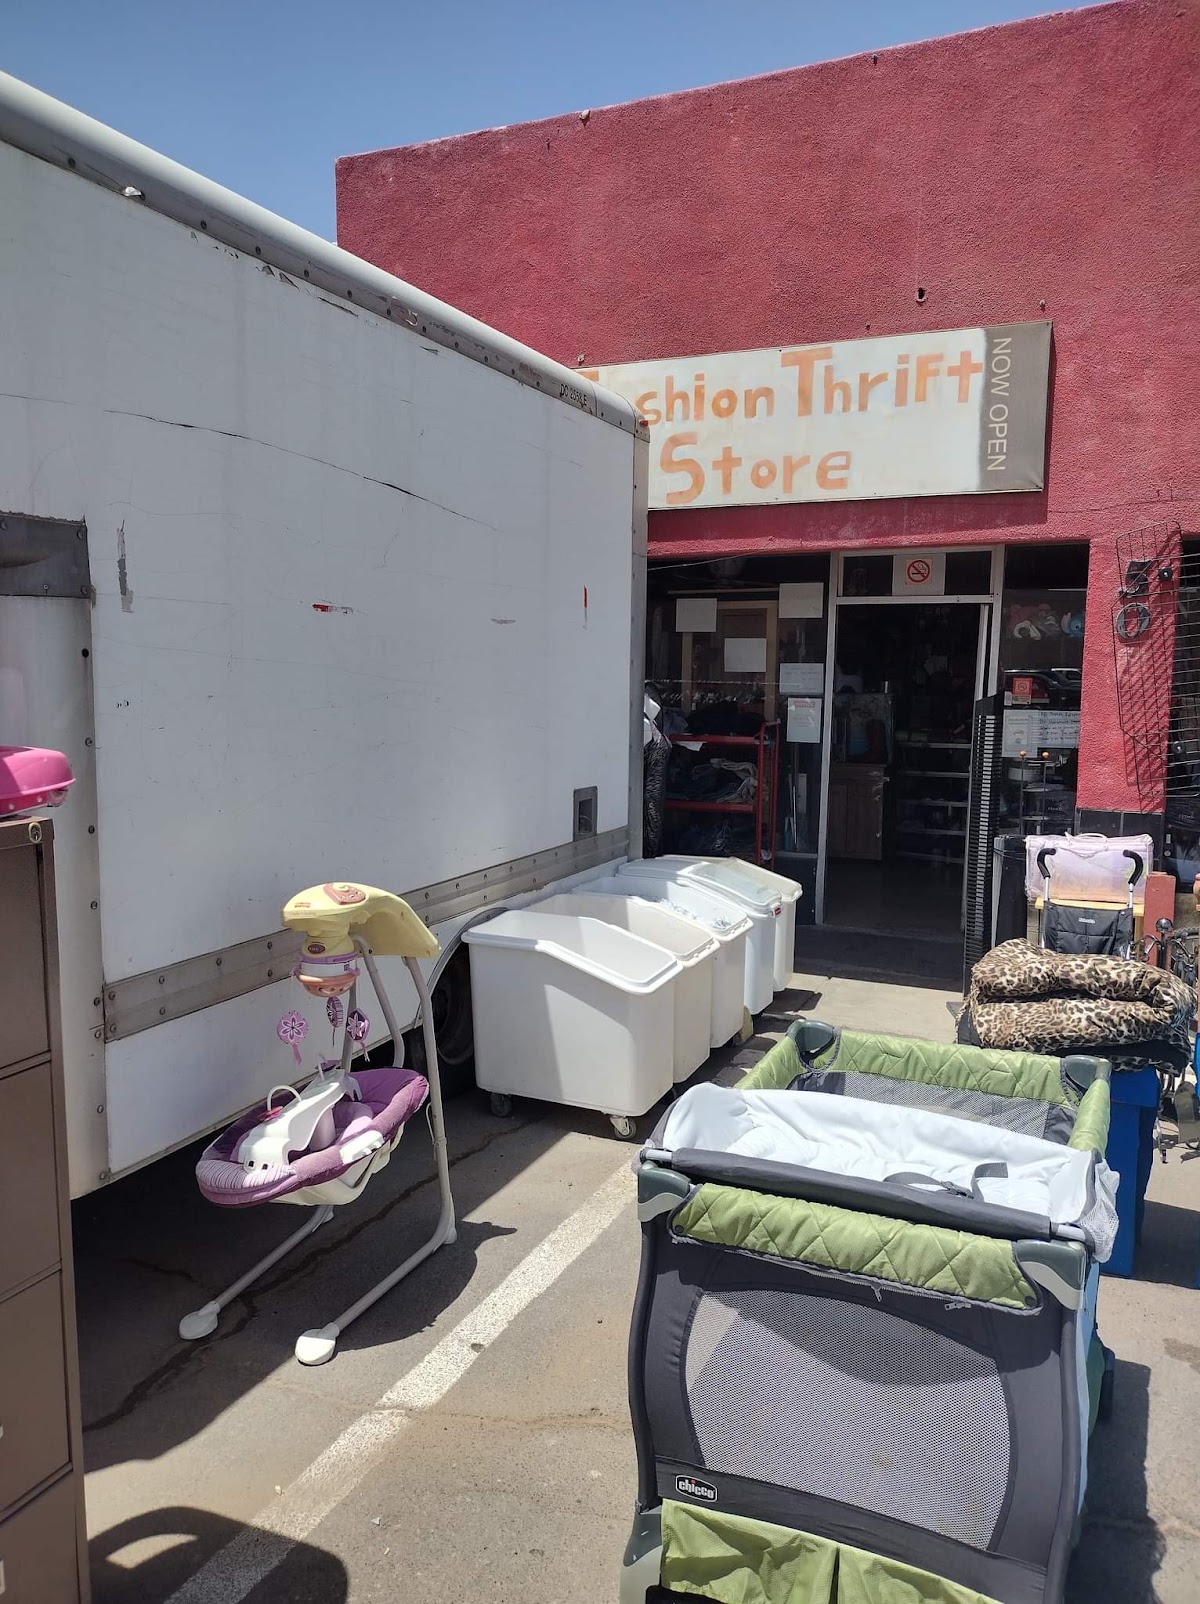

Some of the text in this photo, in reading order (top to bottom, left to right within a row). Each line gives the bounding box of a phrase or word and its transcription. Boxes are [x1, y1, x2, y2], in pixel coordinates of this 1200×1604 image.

[575, 369, 775, 428] shion
[986, 337, 1012, 471] NOW OPEN
[660, 431, 852, 505] Store
[678, 1479, 715, 1499] chicco
